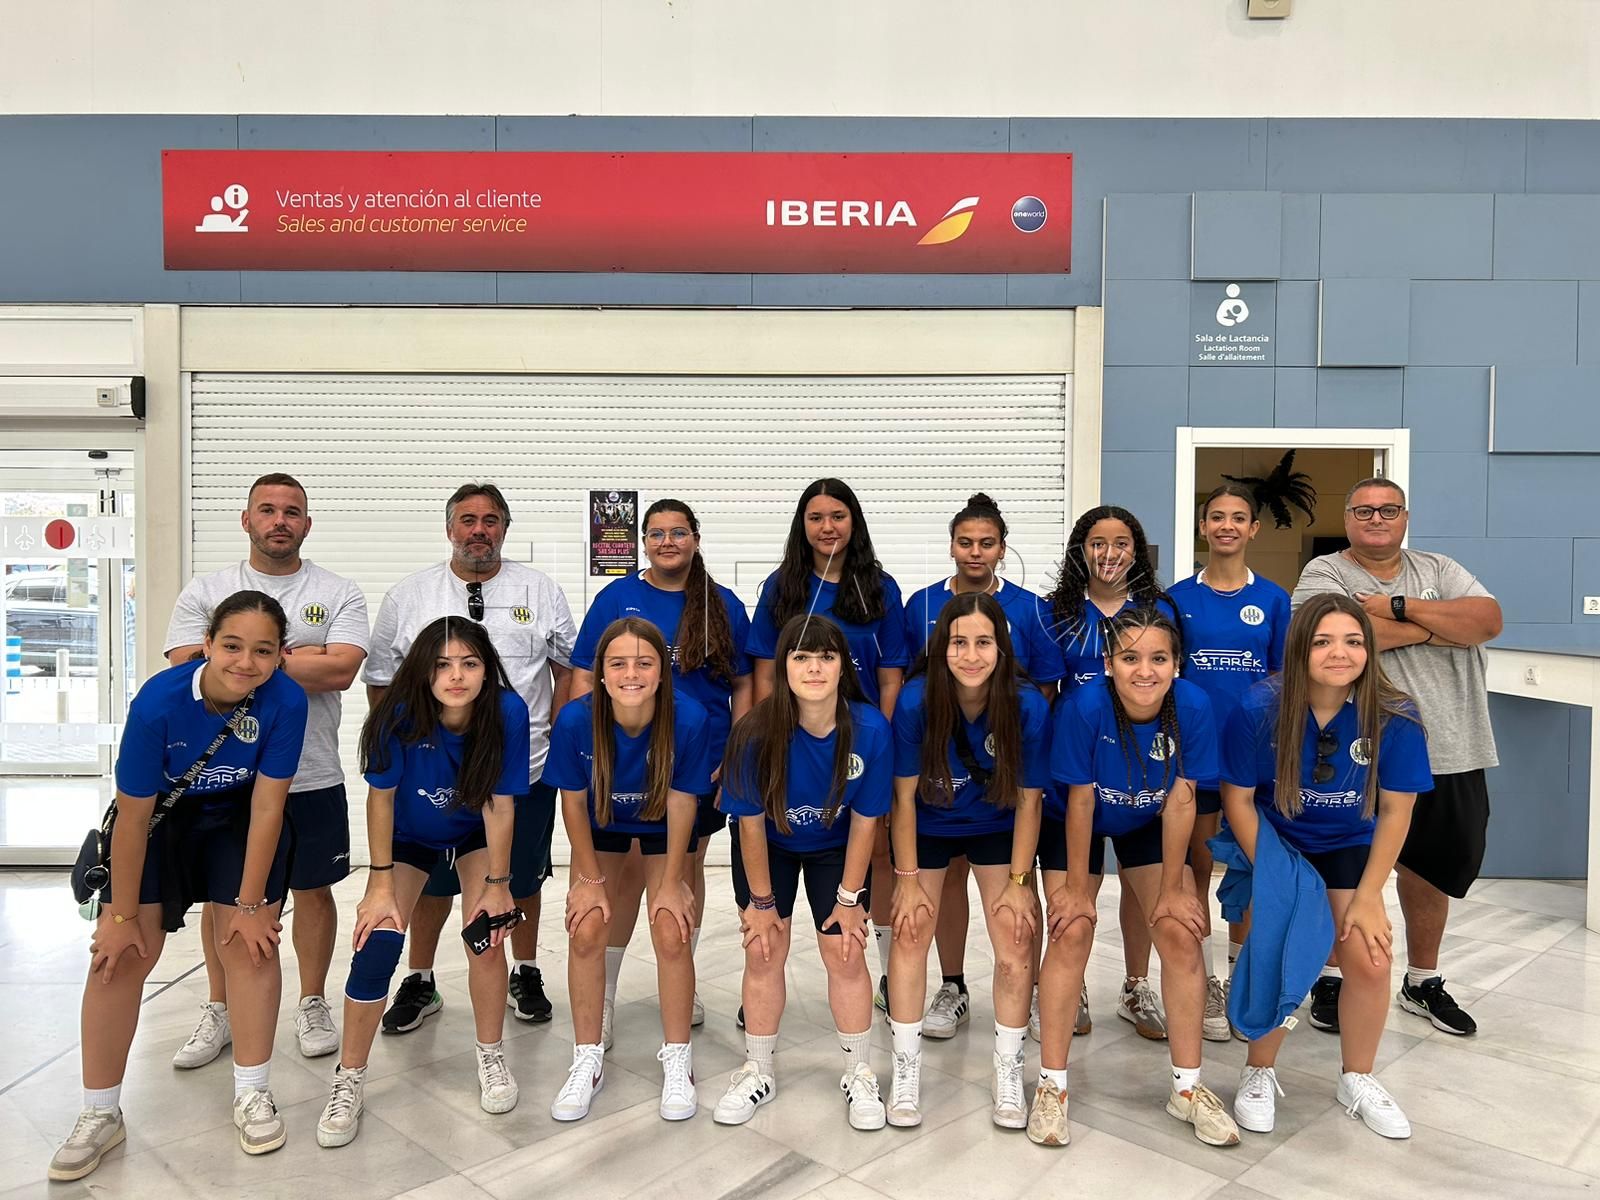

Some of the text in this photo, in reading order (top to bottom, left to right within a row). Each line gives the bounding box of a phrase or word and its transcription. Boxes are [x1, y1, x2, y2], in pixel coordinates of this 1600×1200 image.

[276, 188, 542, 212] Ventas y atención al cliente
[276, 214, 527, 234] Sales and customer service
[766, 199, 918, 227] IBERIA
[1013, 210, 1046, 219] oneworld
[1195, 334, 1269, 343] Sala de Lactancia
[184, 759, 207, 782] BIMBA
[162, 786, 186, 808] BIMBA
